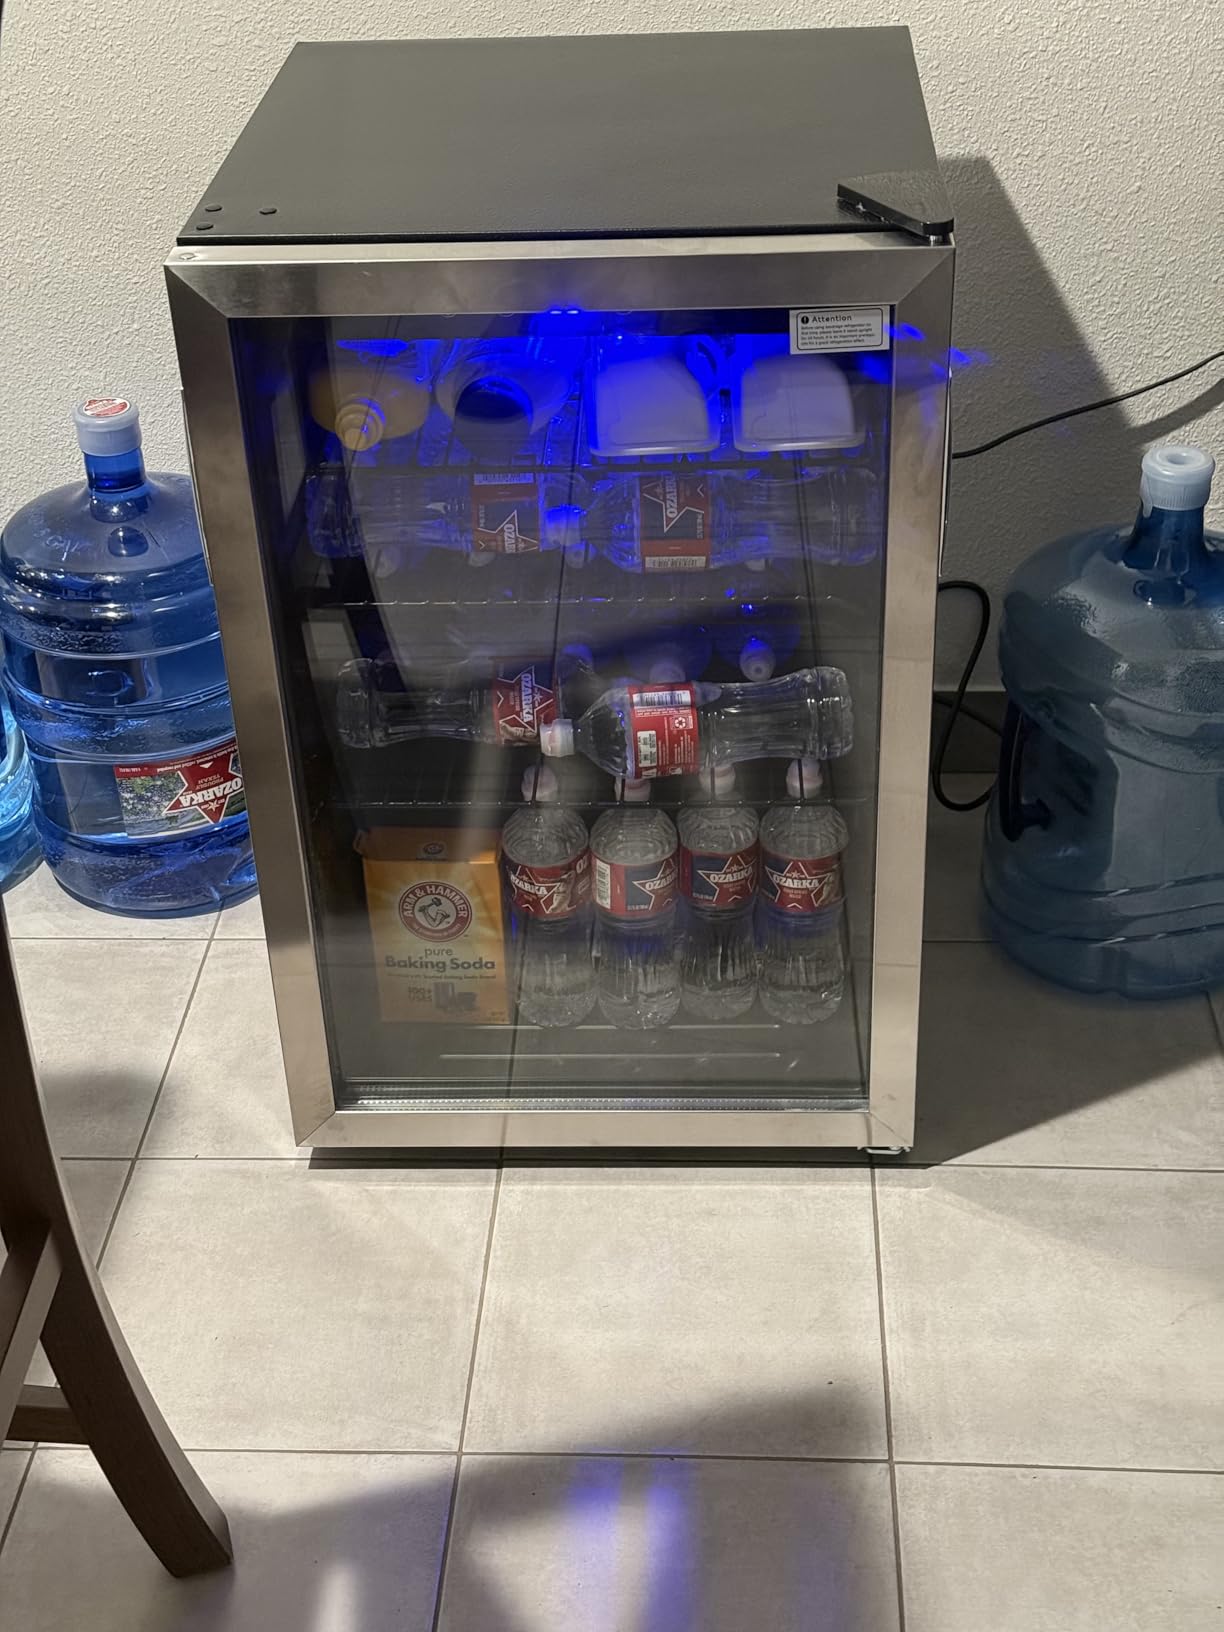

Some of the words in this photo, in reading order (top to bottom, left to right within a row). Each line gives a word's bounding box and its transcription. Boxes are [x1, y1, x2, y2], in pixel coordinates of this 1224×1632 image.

[812, 315, 852, 323] Attention
[521, 672, 534, 722] OZARKA
[179, 778, 242, 807] OZARKA
[709, 865, 753, 883] OZARKA
[772, 874, 820, 889] OZARKA
[403, 891, 418, 918] ARM
[415, 886, 425, 898] &
[425, 884, 468, 918] HAMMER
[424, 946, 454, 959] pure
[385, 955, 446, 972] Baking
[450, 957, 496, 970] Soda
